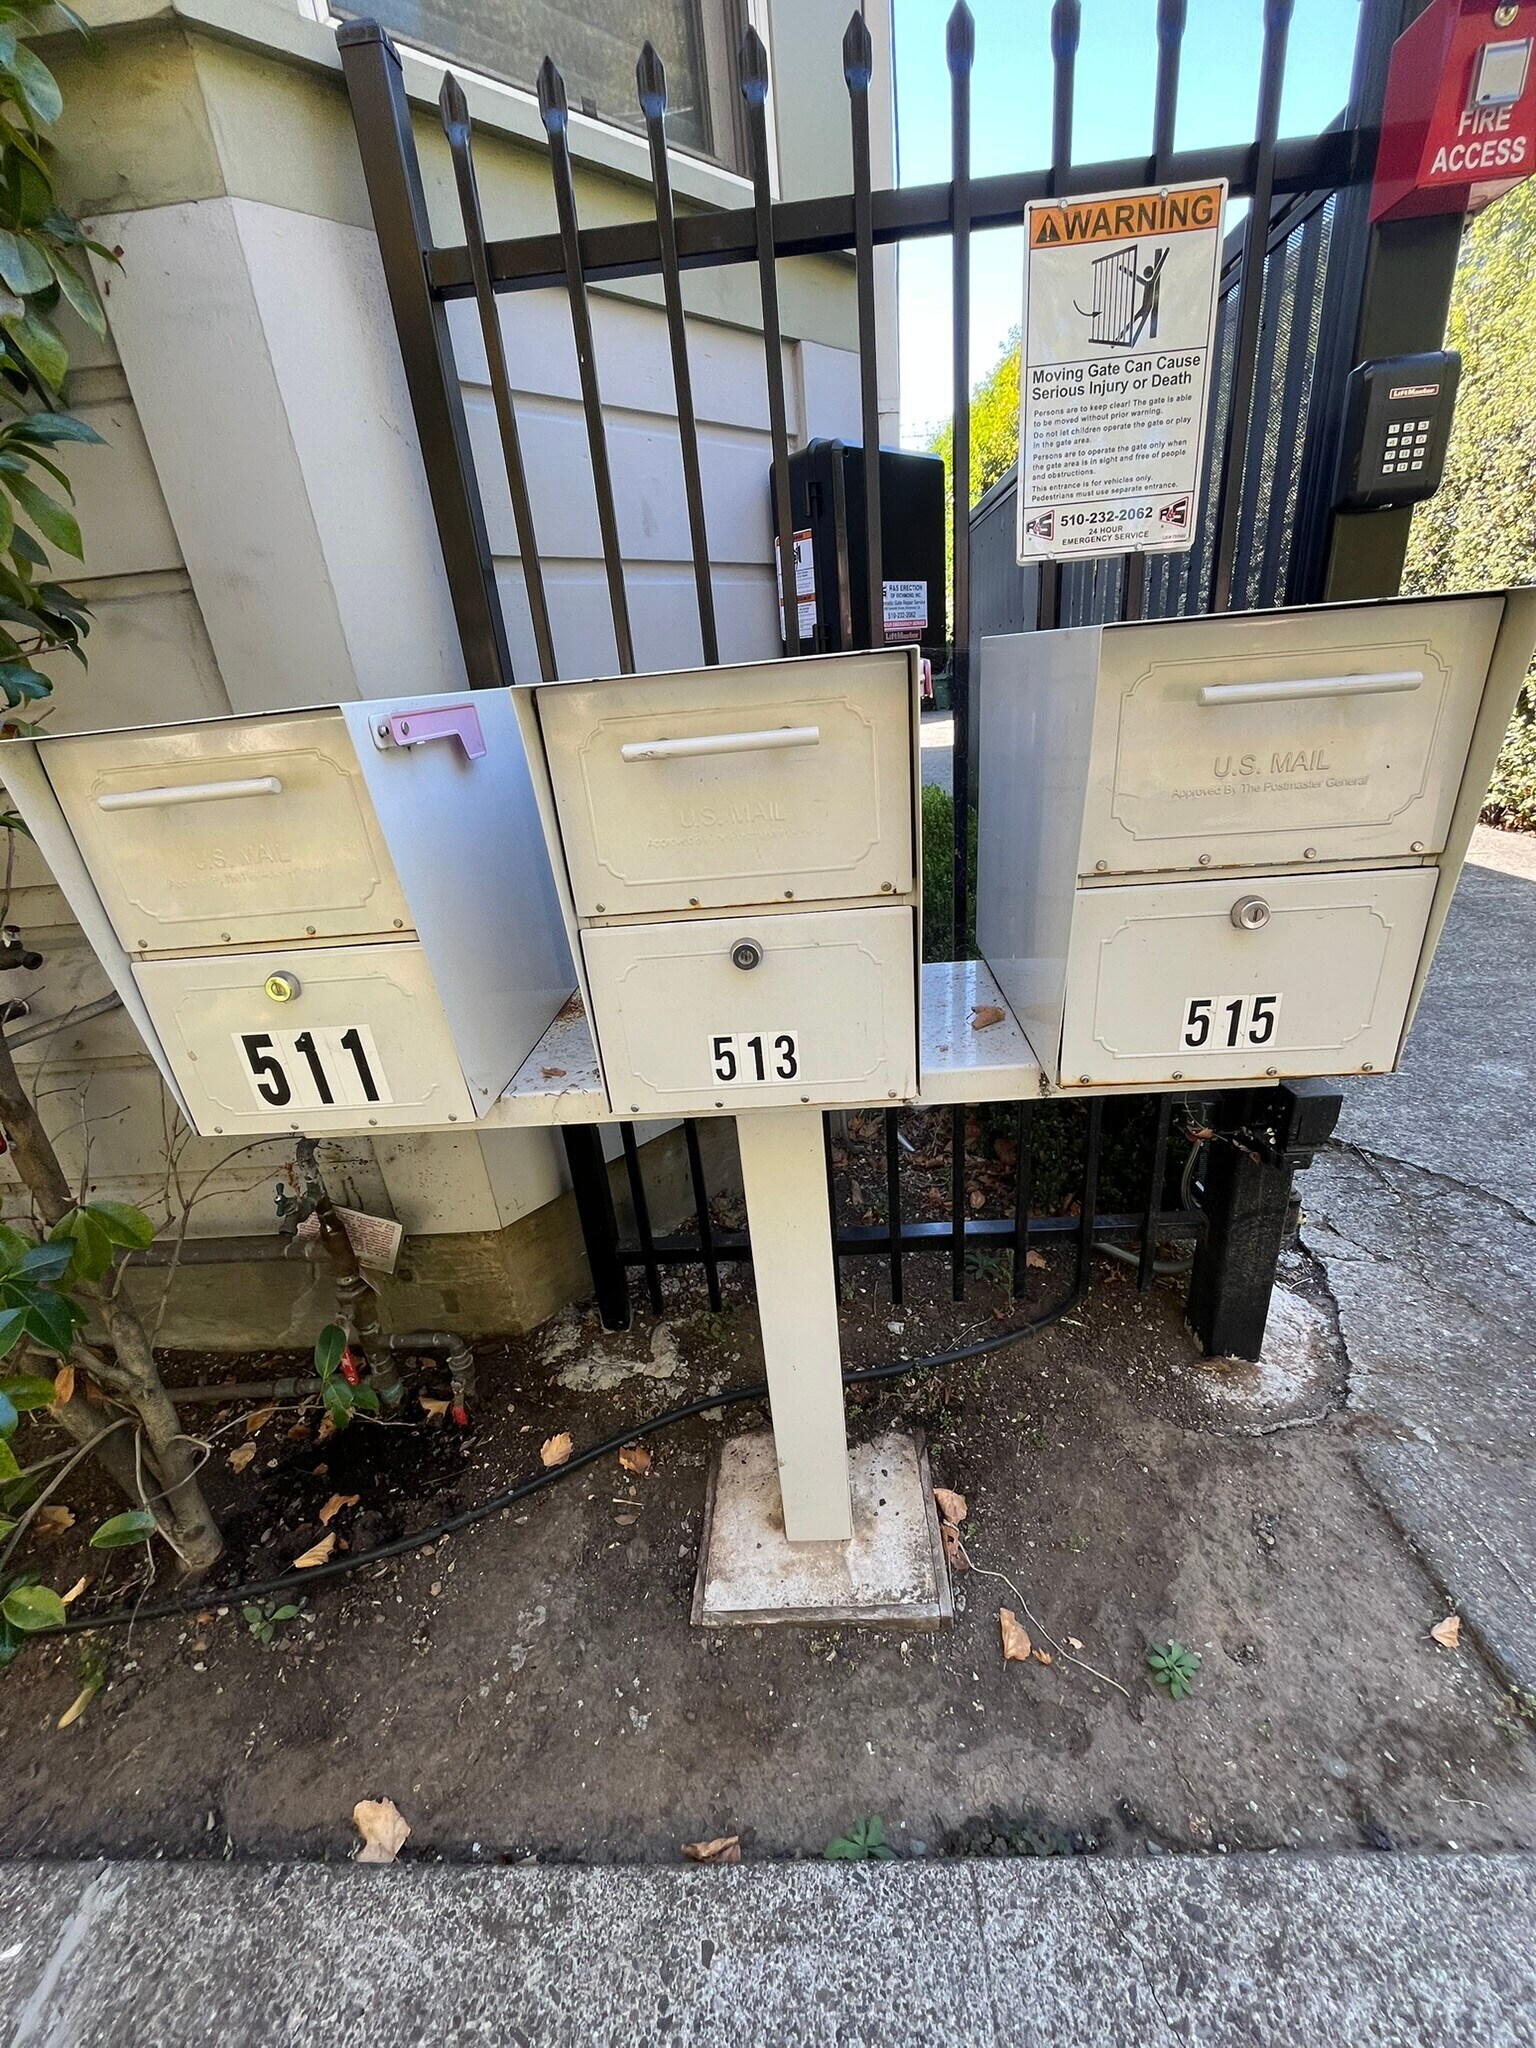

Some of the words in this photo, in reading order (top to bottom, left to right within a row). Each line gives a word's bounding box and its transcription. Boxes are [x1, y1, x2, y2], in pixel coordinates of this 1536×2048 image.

[1458, 104, 1513, 136] FIRE
[1430, 136, 1526, 174] ACCESS
[1064, 196, 1214, 240] WARNING
[1032, 368, 1083, 384] Moving
[1088, 364, 1120, 378] Gate
[1125, 360, 1152, 374] Can
[1156, 355, 1200, 370] Cause
[1032, 385, 1084, 400] Serious
[1090, 380, 1128, 397] Injury
[1133, 378, 1148, 389] or
[1152, 372, 1192, 387] Death
[1034, 408, 1064, 417] Persons
[1110, 400, 1130, 409] clear!
[1149, 397, 1165, 406] gate
[1054, 416, 1079, 425] moved
[1081, 413, 1109, 422] without
[1111, 412, 1129, 420] prior
[1131, 408, 1163, 416] warning.
[1071, 425, 1101, 435] children
[1103, 423, 1131, 432] operate
[1148, 420, 1164, 428] gate
[1176, 416, 1192, 424] play
[1033, 453, 1062, 461] Persons
[1088, 447, 1115, 456] operate
[1131, 443, 1147, 452] gate
[1150, 441, 1165, 449] only
[1056, 439, 1072, 448] gate
[1046, 462, 1062, 471] gate
[1099, 456, 1118, 464] sight
[1120, 454, 1133, 462] and
[1135, 452, 1149, 460] free
[1161, 448, 1186, 458] people
[1033, 472, 1046, 480] and
[1048, 469, 1096, 479] obstructions.
[1049, 482, 1080, 491] entrance
[1104, 476, 1133, 485] vehicles
[1136, 474, 1153, 482] only.
[1032, 493, 1074, 502] Pedestrians
[1111, 484, 1142, 494] separate
[1144, 482, 1178, 490] entrance.
[1061, 507, 1153, 526] 510-232-2062
[1062, 535, 1112, 545] EMERGENCY
[1115, 531, 1149, 540] SERVICE
[1213, 754, 1262, 777] U.S.
[1270, 749, 1330, 774] MAIL
[1172, 787, 1221, 800] Approved
[1241, 783, 1260, 794] The
[1264, 780, 1322, 792] Postmaster
[1326, 776, 1370, 788] General
[680, 807, 722, 828] U.S.
[731, 801, 785, 824] MAIL
[1185, 996, 1276, 1046] 515
[241, 1028, 380, 1106] 511
[714, 1035, 798, 1080] 513
